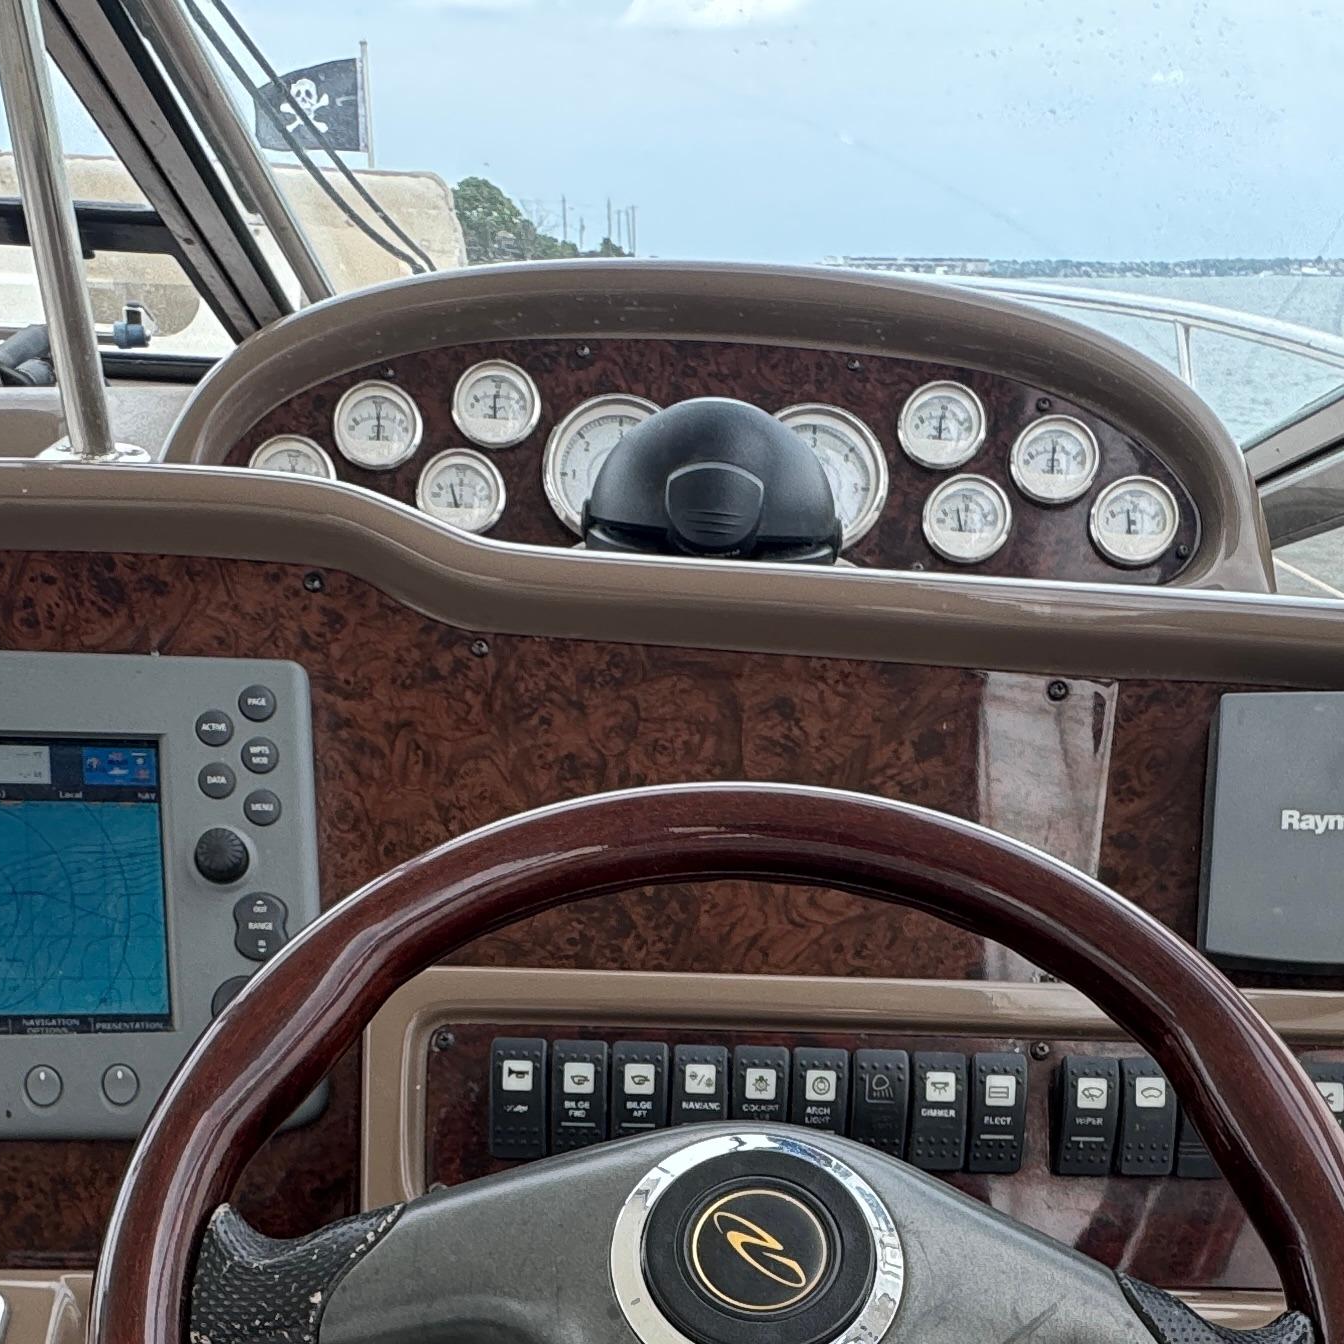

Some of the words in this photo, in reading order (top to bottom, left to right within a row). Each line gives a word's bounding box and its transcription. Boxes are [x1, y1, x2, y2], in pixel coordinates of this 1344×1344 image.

[201, 723, 227, 731] ACTIVE
[206, 775, 227, 785] DATA
[564, 1100, 590, 1109] BILGE
[626, 1101, 653, 1109] BILGE
[632, 1109, 648, 1118] AFT
[806, 1106, 831, 1115] ARCH
[921, 1108, 956, 1118] DIMMER
